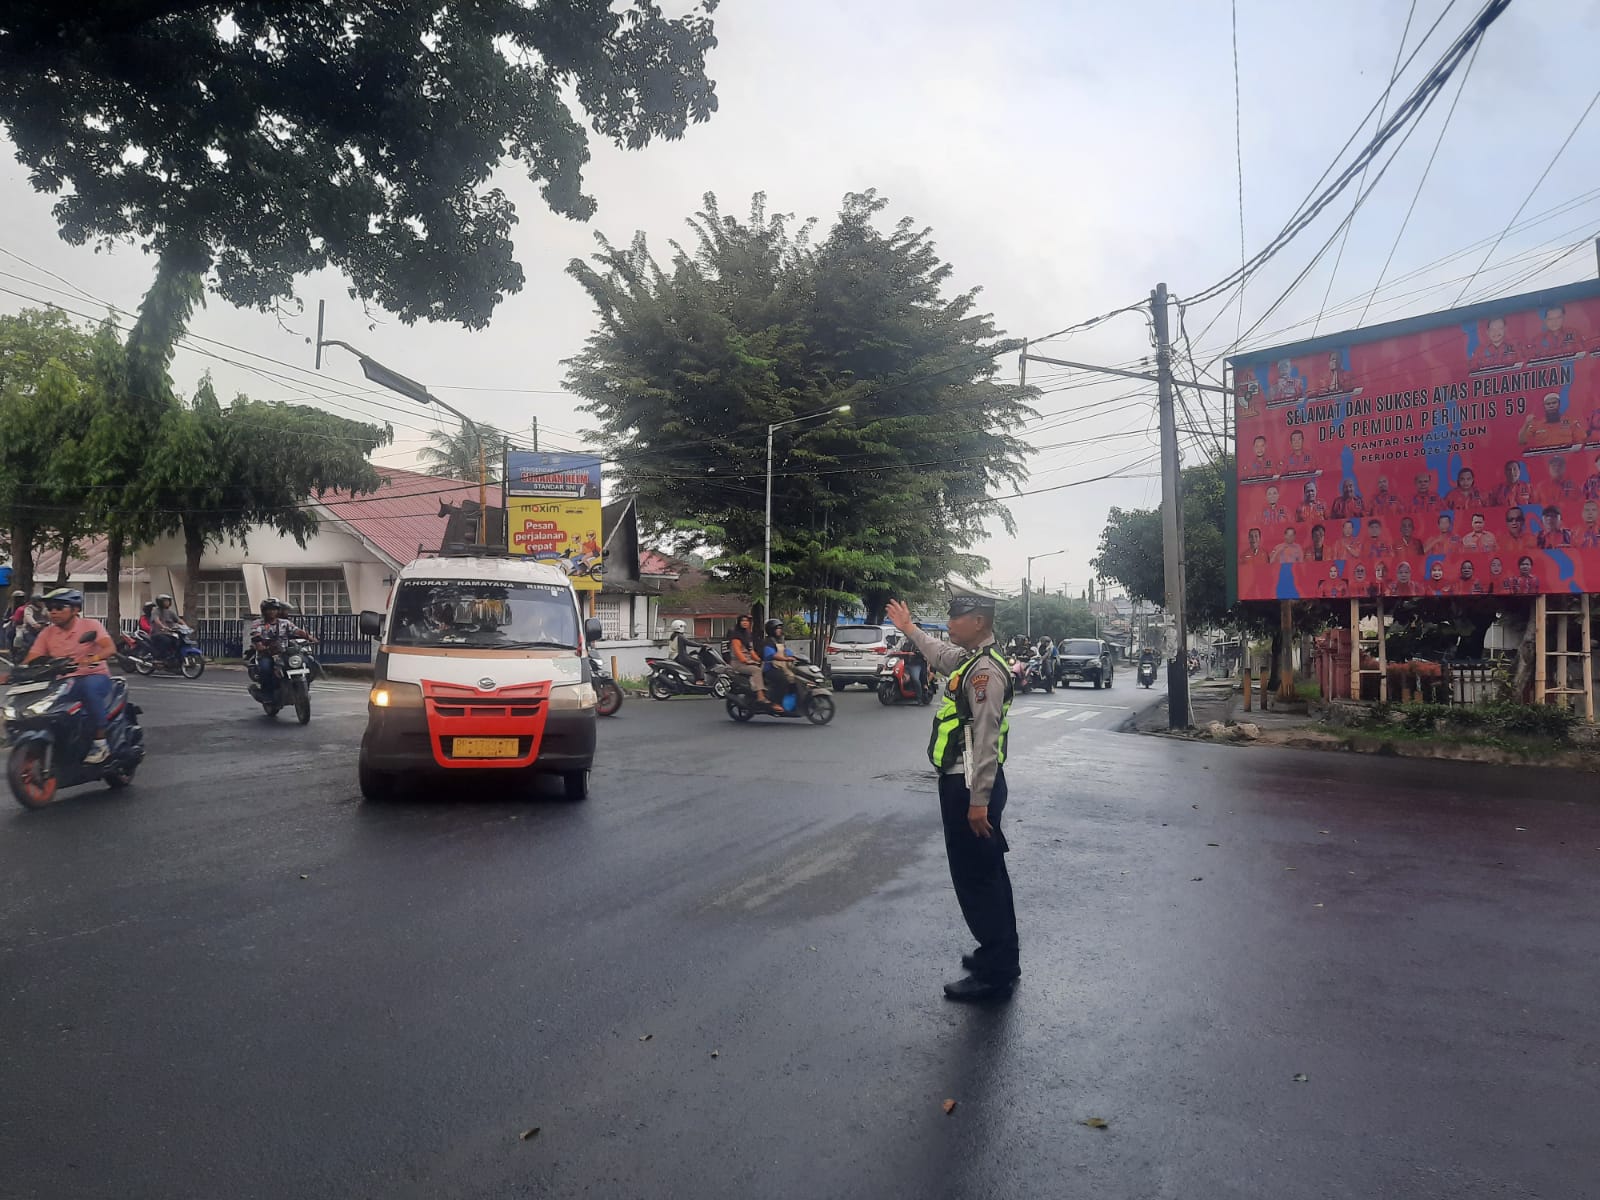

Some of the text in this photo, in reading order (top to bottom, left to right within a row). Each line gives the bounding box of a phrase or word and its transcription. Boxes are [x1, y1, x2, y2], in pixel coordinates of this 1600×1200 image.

[1286, 401, 1341, 426] SELAMAT
[1345, 399, 1371, 418] DAN
[1376, 388, 1429, 413] SUKSES
[1432, 382, 1468, 404] ATAS
[1473, 365, 1573, 398] PELANTIKAN
[1319, 397, 1526, 442] DPC PEMUDA PERINTIS 59
[1350, 426, 1487, 451] SIANTAR SIMALUNGUN
[1361, 450, 1409, 463] PERIODE
[521, 504, 560, 513] maxim
[526, 521, 554, 530] Pesan
[515, 532, 564, 542] perjalanan
[527, 543, 553, 552] cepat
